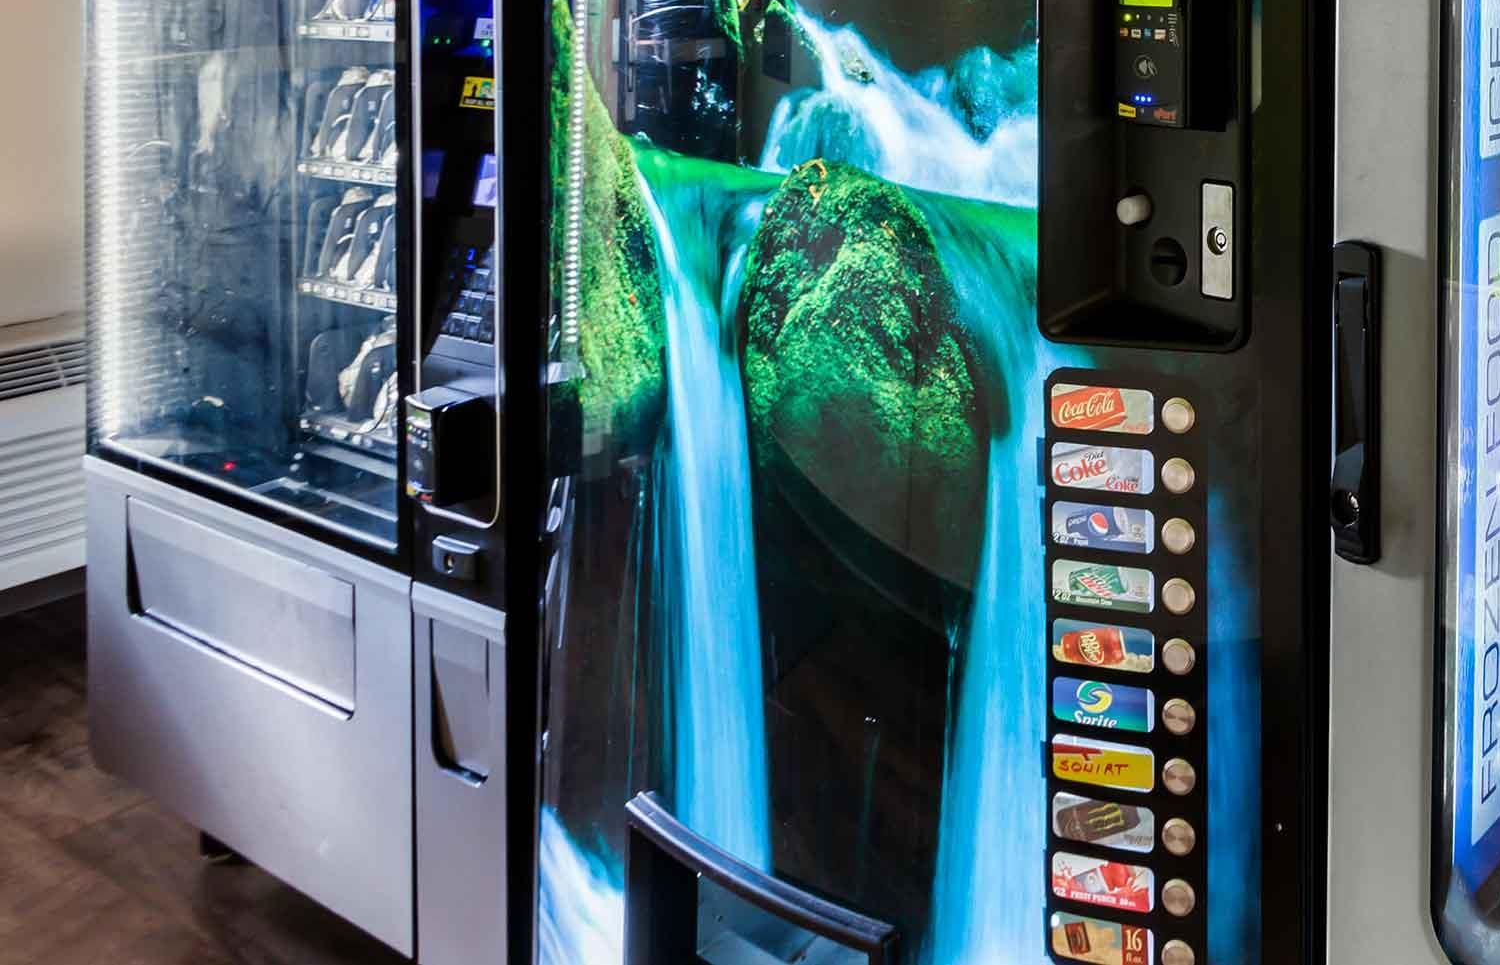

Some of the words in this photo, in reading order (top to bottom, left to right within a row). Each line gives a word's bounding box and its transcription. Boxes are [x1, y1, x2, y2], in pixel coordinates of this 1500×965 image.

[1055, 458, 1108, 484] Coke
[1480, 482, 1500, 804] FROZEN
[1073, 710, 1118, 728] Sprite
[1125, 928, 1143, 951] 16
